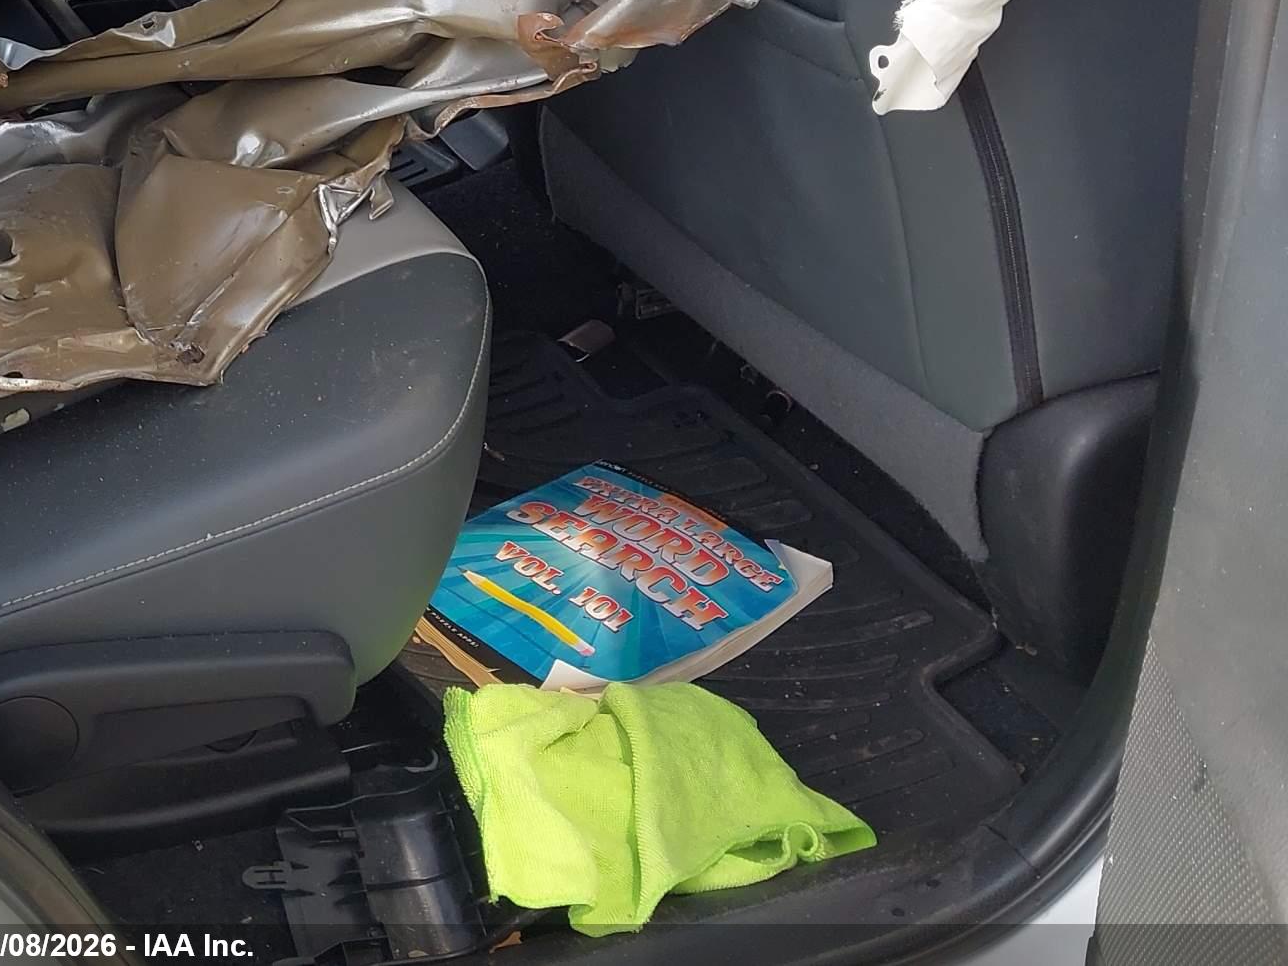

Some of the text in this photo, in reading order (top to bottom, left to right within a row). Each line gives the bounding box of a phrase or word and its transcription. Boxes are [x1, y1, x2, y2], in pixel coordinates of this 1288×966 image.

[506, 501, 729, 631] SEARCH
[573, 475, 680, 524] EXTRA
[674, 518, 785, 592] LARGE
[573, 494, 730, 586] WORD
[495, 541, 635, 632] VOL. 101
